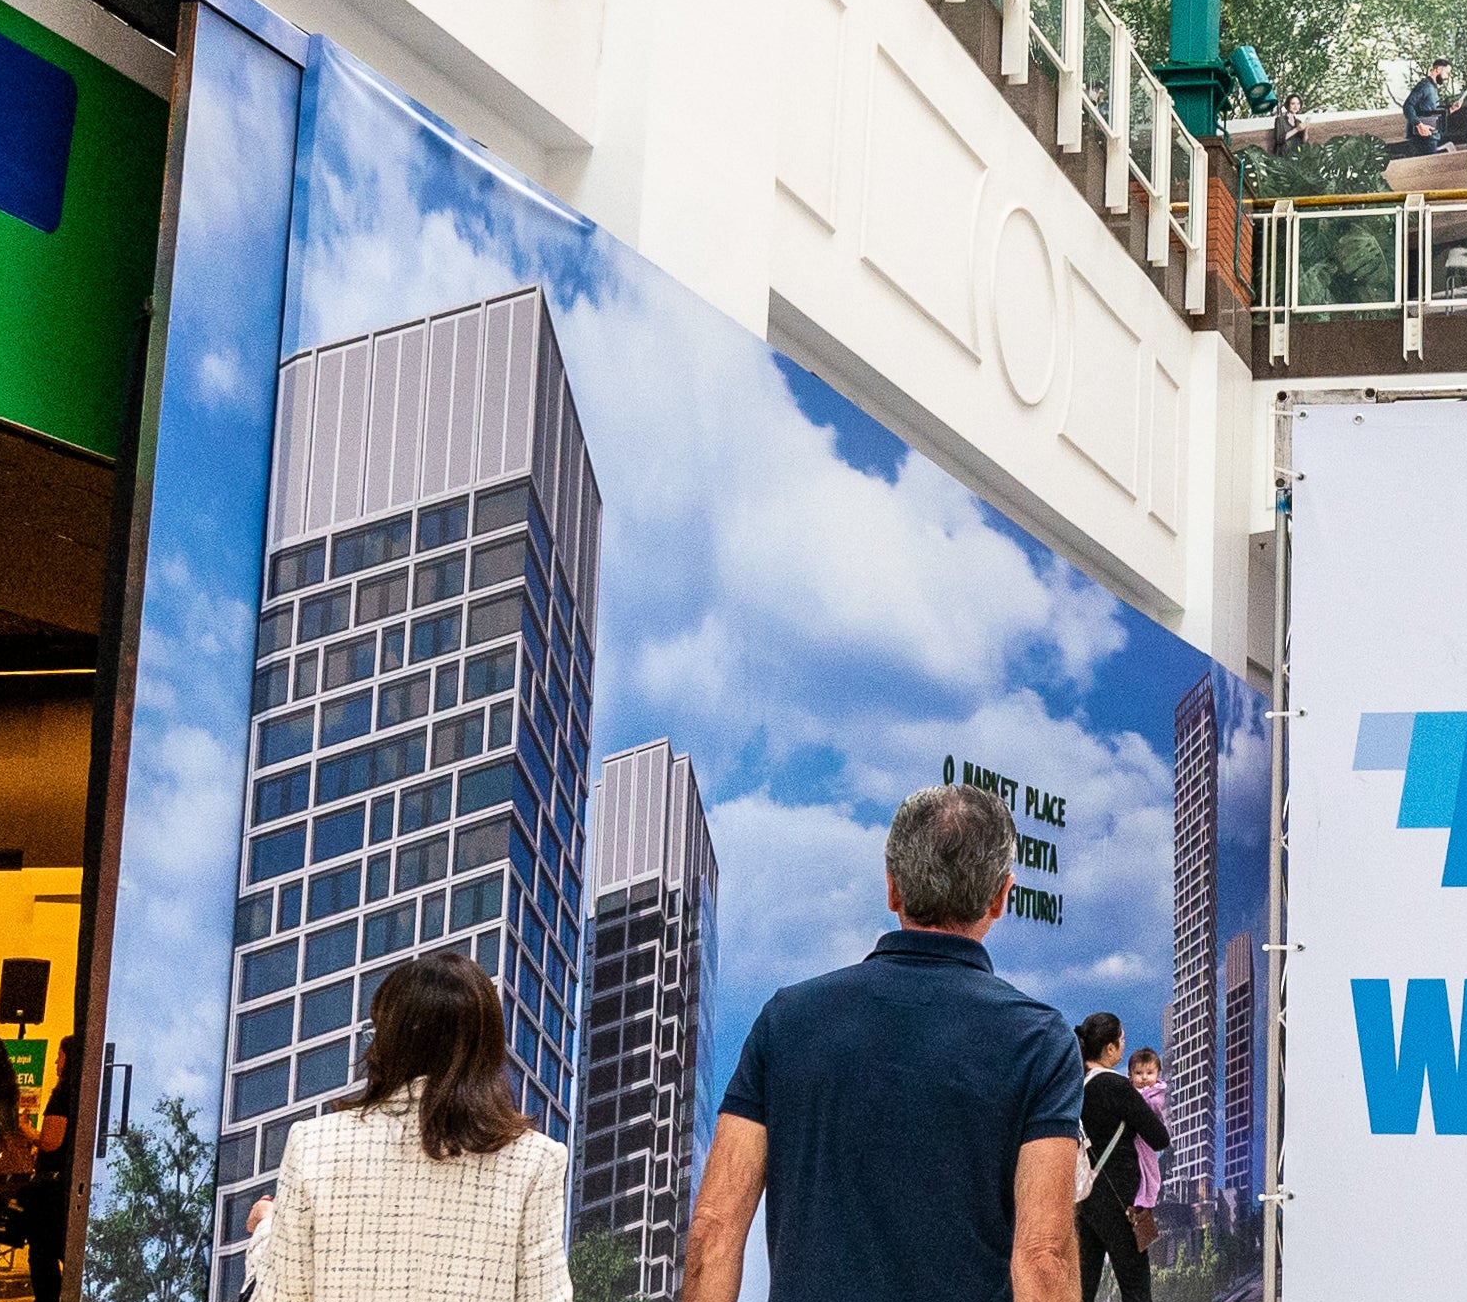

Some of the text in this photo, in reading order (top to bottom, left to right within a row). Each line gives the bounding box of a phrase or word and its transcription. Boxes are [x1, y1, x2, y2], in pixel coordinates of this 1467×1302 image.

[943, 755, 955, 785] O
[1026, 786, 1066, 827] PLACE
[1007, 884, 1063, 925] FUTURO!
